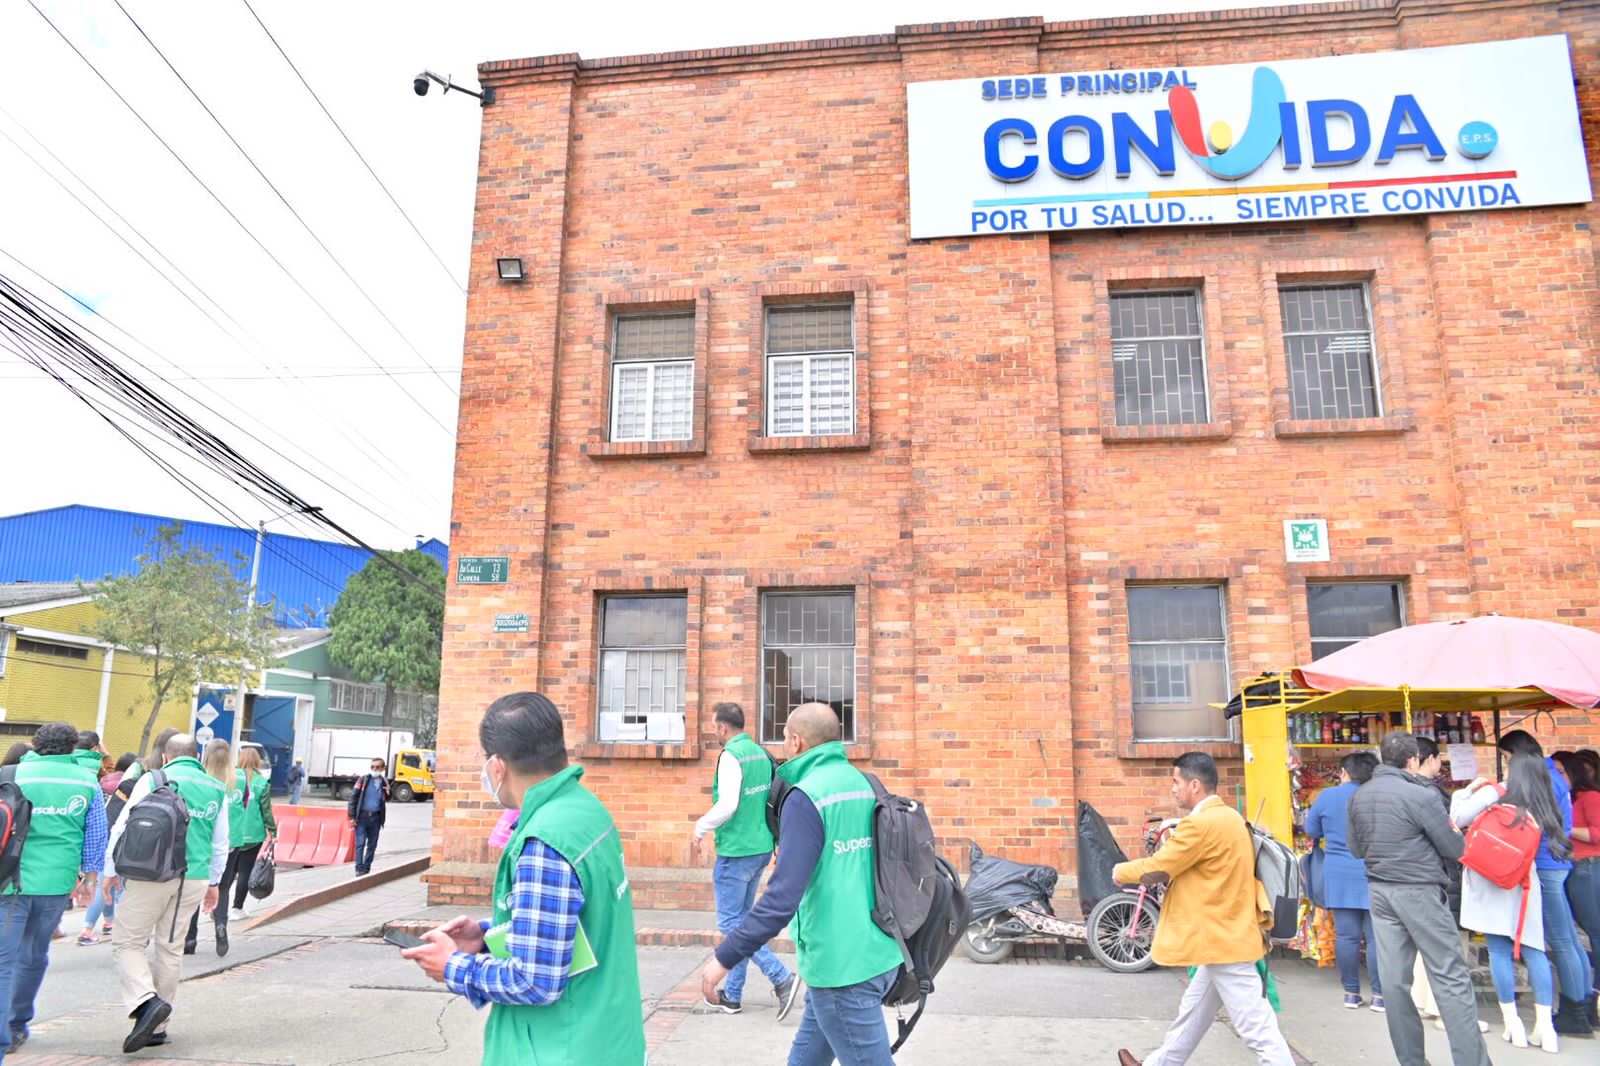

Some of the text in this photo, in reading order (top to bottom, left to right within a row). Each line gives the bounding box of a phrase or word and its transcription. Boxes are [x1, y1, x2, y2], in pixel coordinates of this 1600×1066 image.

[981, 69, 1198, 100] SEDE PRINCIPAL
[970, 183, 1521, 233] POR TU SALUD... SIEMPRE CONVIDA
